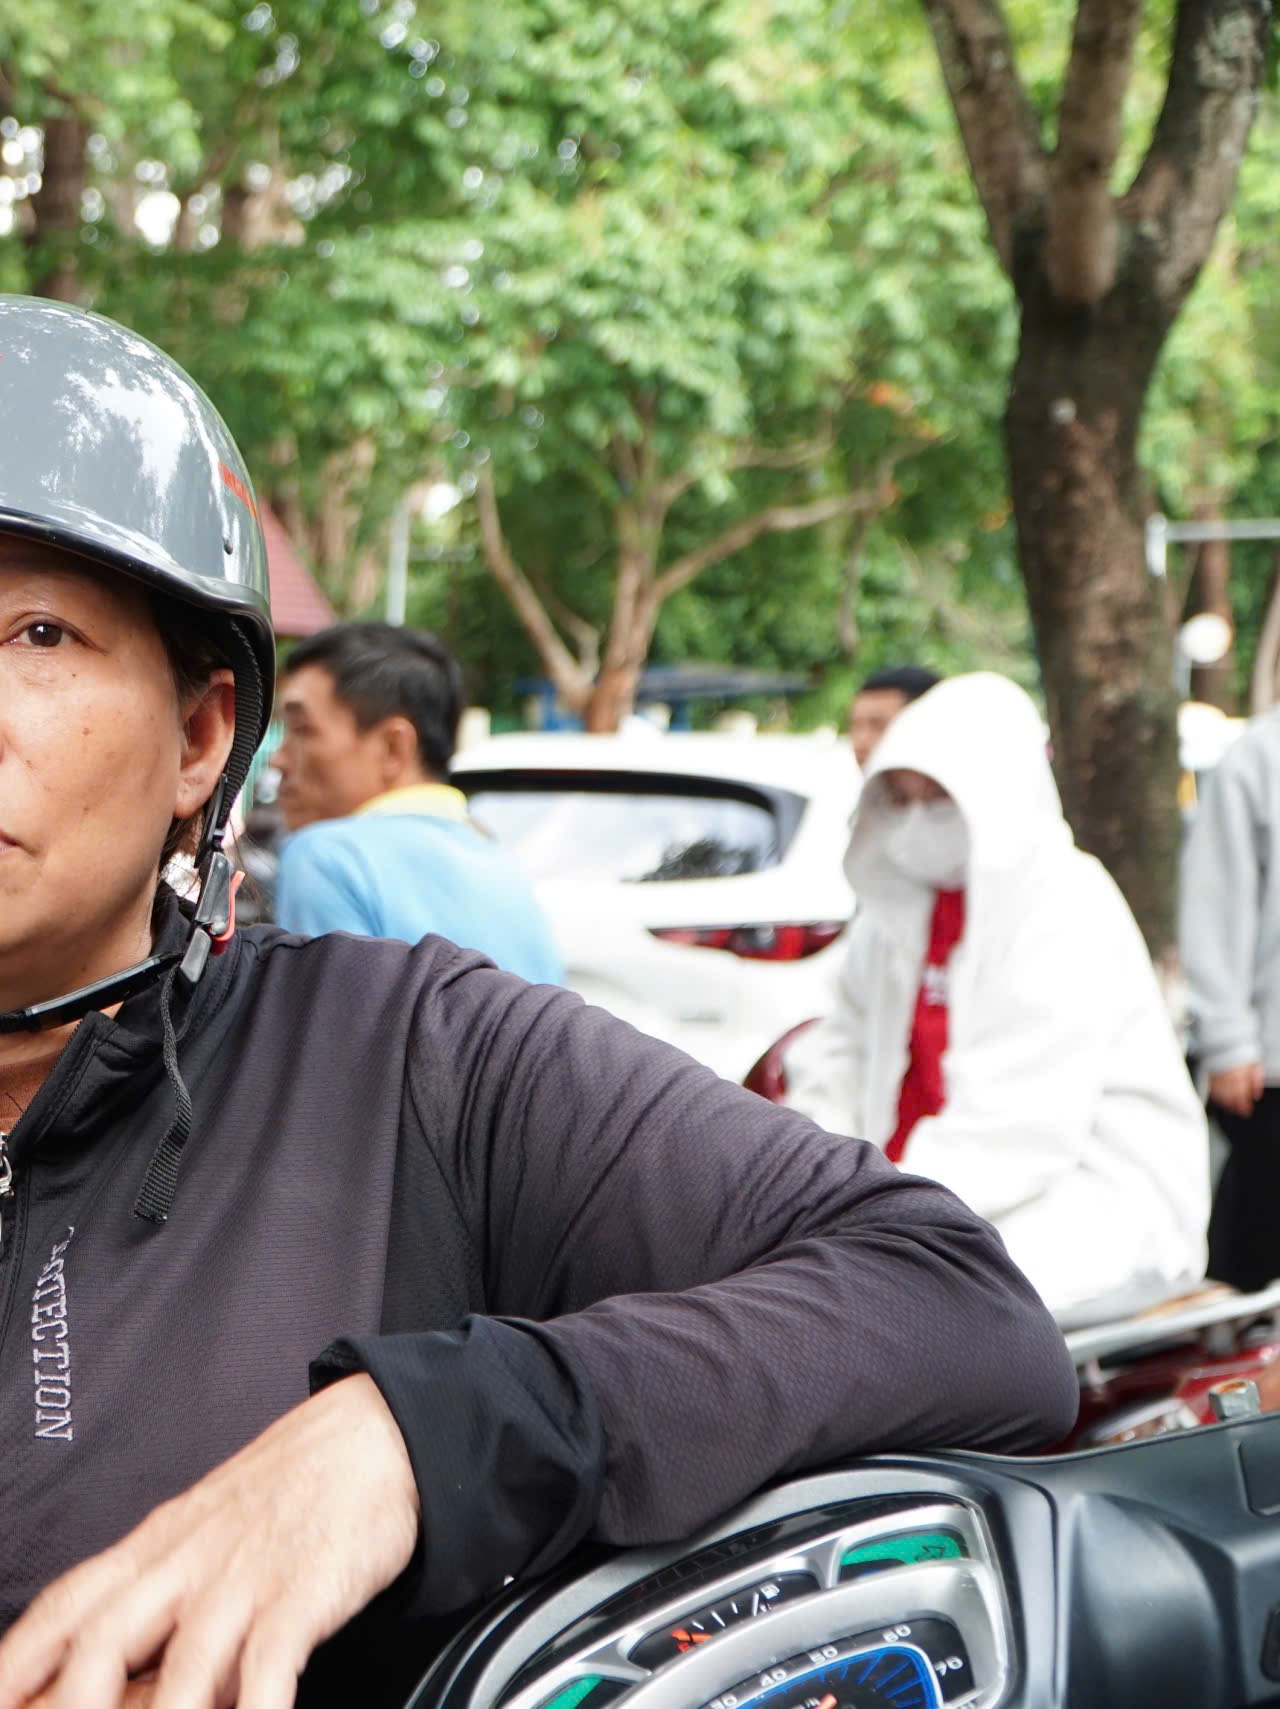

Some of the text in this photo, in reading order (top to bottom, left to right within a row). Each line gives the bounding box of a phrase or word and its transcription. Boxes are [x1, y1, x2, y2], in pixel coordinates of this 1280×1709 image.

[882, 1624, 912, 1643] 60
[808, 1645, 839, 1666] 50
[934, 1656, 964, 1677] 70
[761, 1669, 787, 1687] 40
